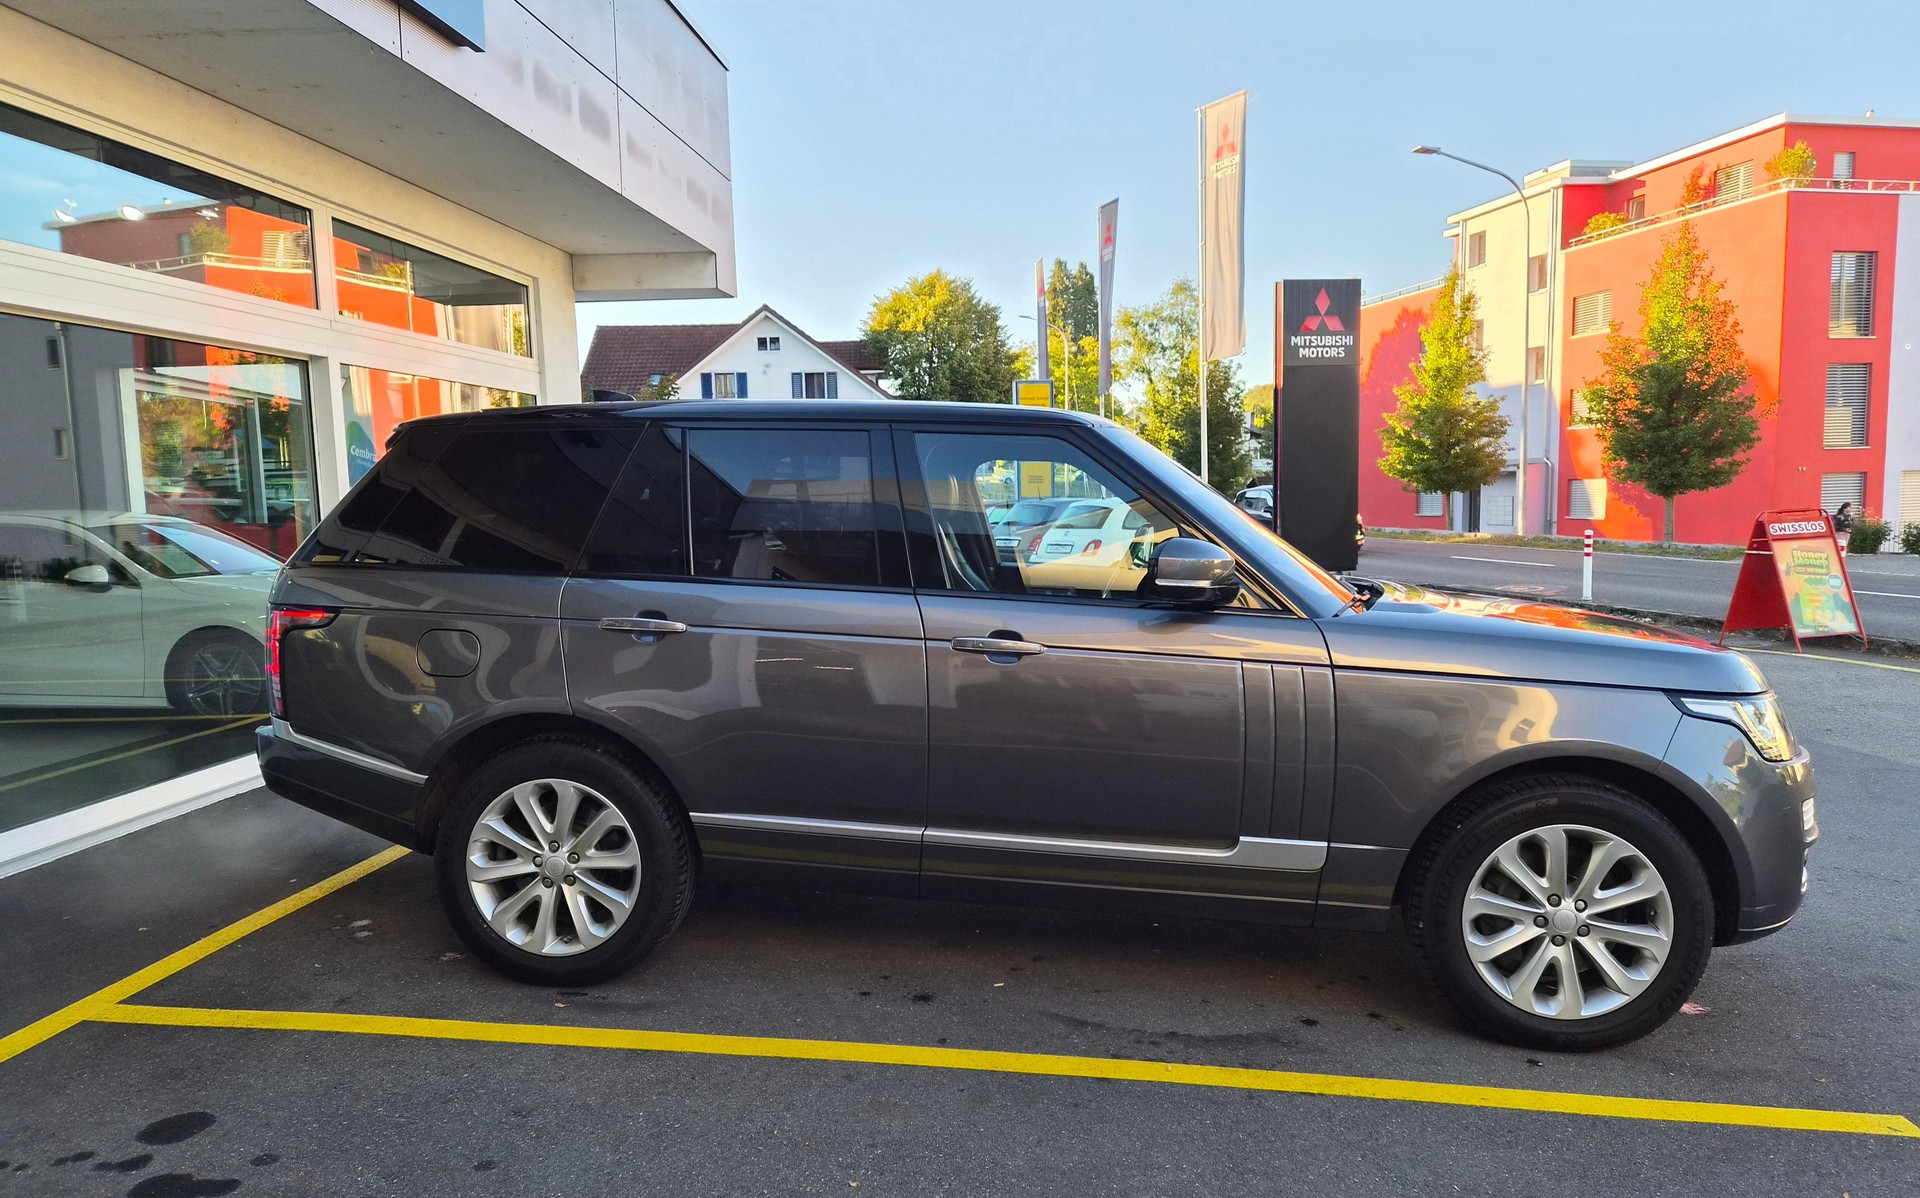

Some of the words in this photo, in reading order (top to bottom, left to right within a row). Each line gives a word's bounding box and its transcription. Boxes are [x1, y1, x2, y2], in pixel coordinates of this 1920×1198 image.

[1290, 335, 1353, 346] MITSUBISHI
[1299, 347, 1345, 358] MOTORS
[350, 445, 376, 461] Cembra
[1770, 522, 1826, 534] SWISSLOS
